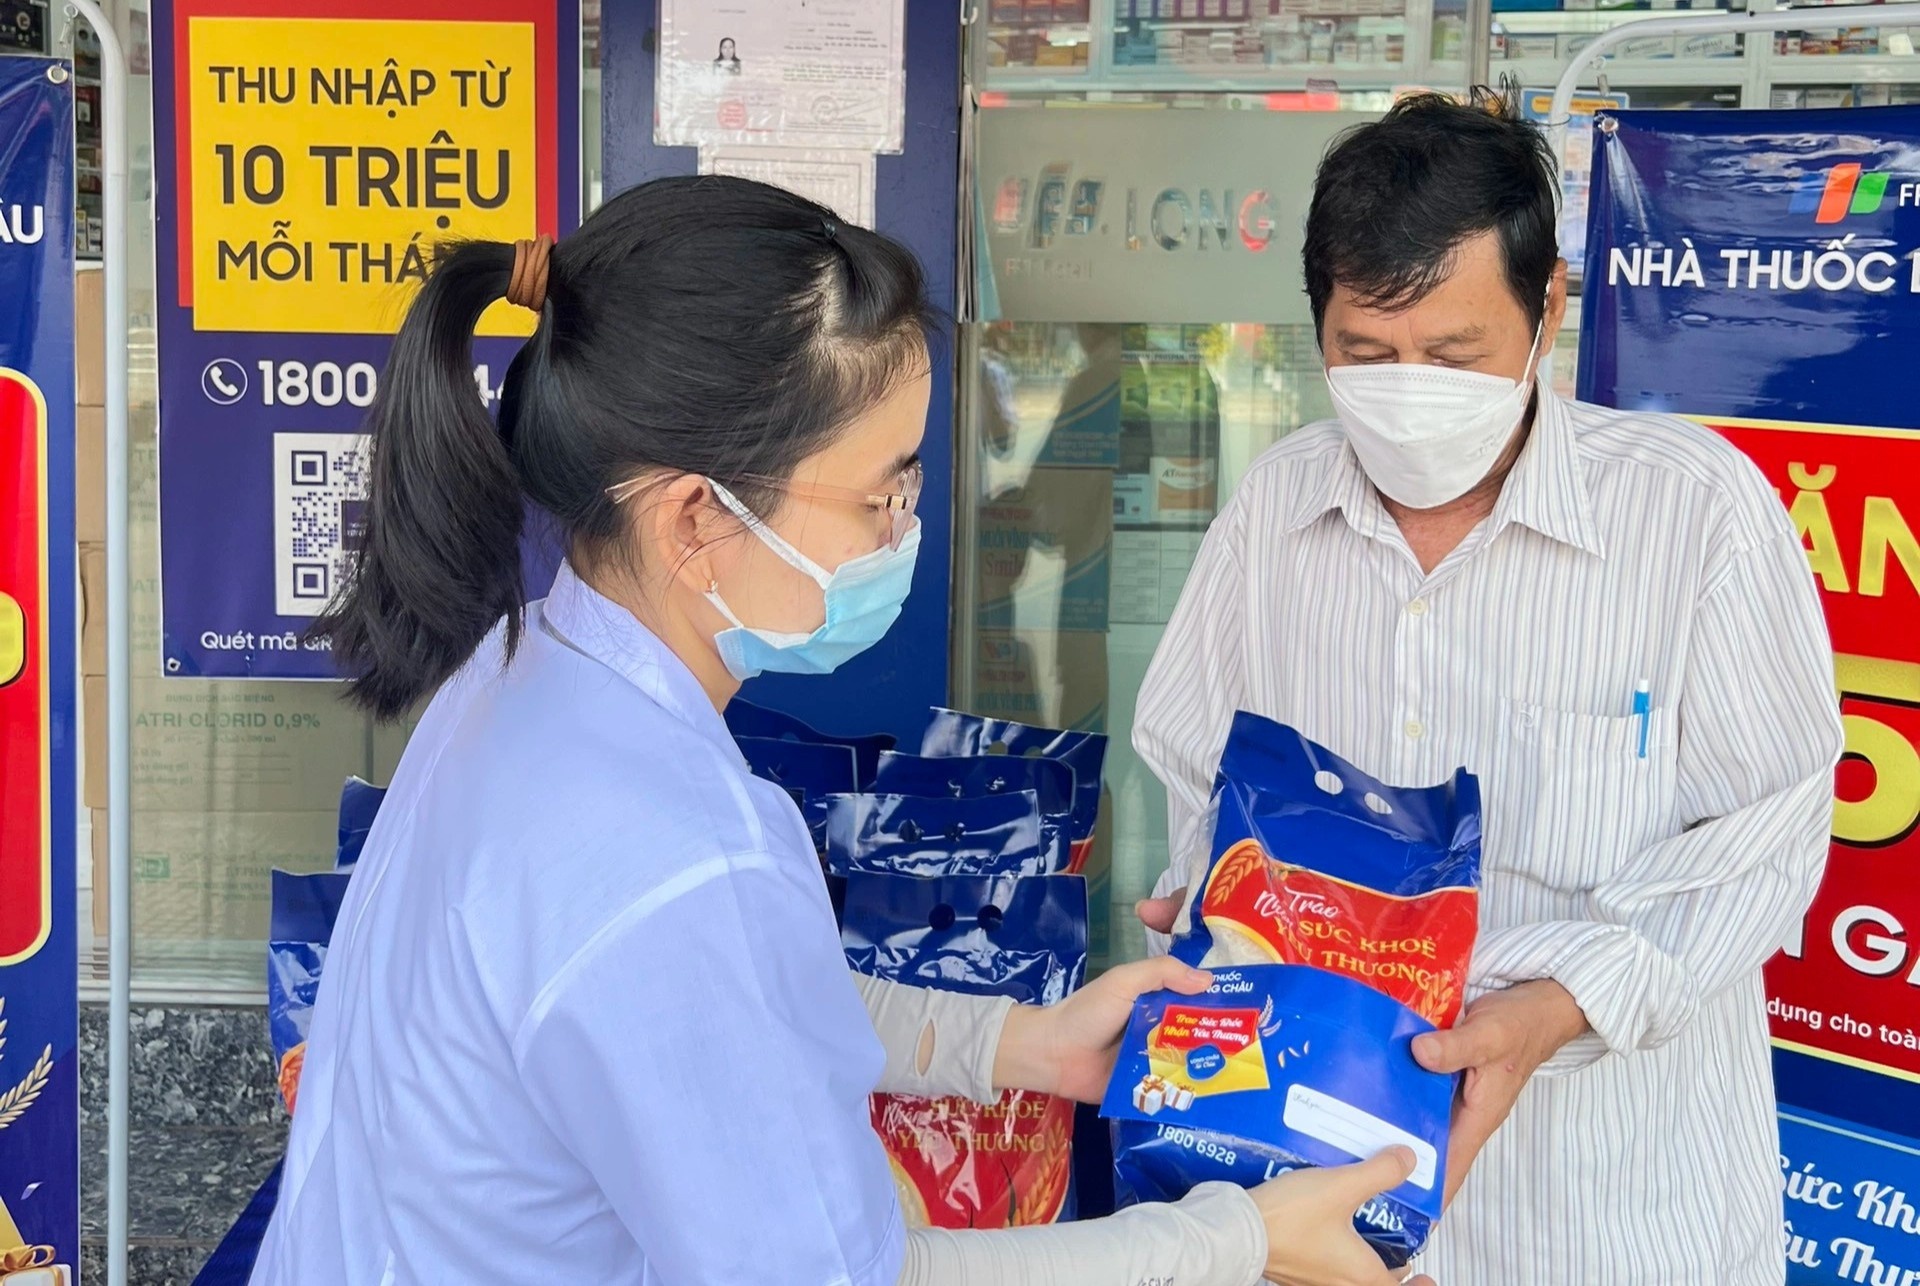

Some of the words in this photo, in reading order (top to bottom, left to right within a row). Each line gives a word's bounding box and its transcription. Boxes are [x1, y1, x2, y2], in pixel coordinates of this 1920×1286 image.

[209, 66, 295, 103] THU
[311, 58, 437, 118] NHẬP
[450, 59, 512, 108] TỪ
[214, 143, 285, 205] 10
[309, 129, 511, 229] TRIỆU
[1126, 187, 1277, 251] LONG
[218, 220, 313, 282] MỖI
[1608, 237, 1705, 288] NHÀ
[1720, 233, 1897, 293] THUỐC
[258, 359, 378, 407] 1800
[200, 630, 255, 651] Quét
[260, 632, 297, 651] mã
[273, 712, 321, 730] 0,9%
[1284, 886, 1339, 918] Trao
[1222, 980, 1253, 993] CHÂU
[1175, 1013, 1198, 1024] Trao
[1767, 997, 1823, 1029] dụng
[1829, 1013, 1872, 1038] cho
[1878, 1024, 1920, 1050] toà
[1157, 1123, 1194, 1149] 1800
[1196, 1139, 1237, 1166] 6928
[1853, 1180, 1920, 1236] Kh
